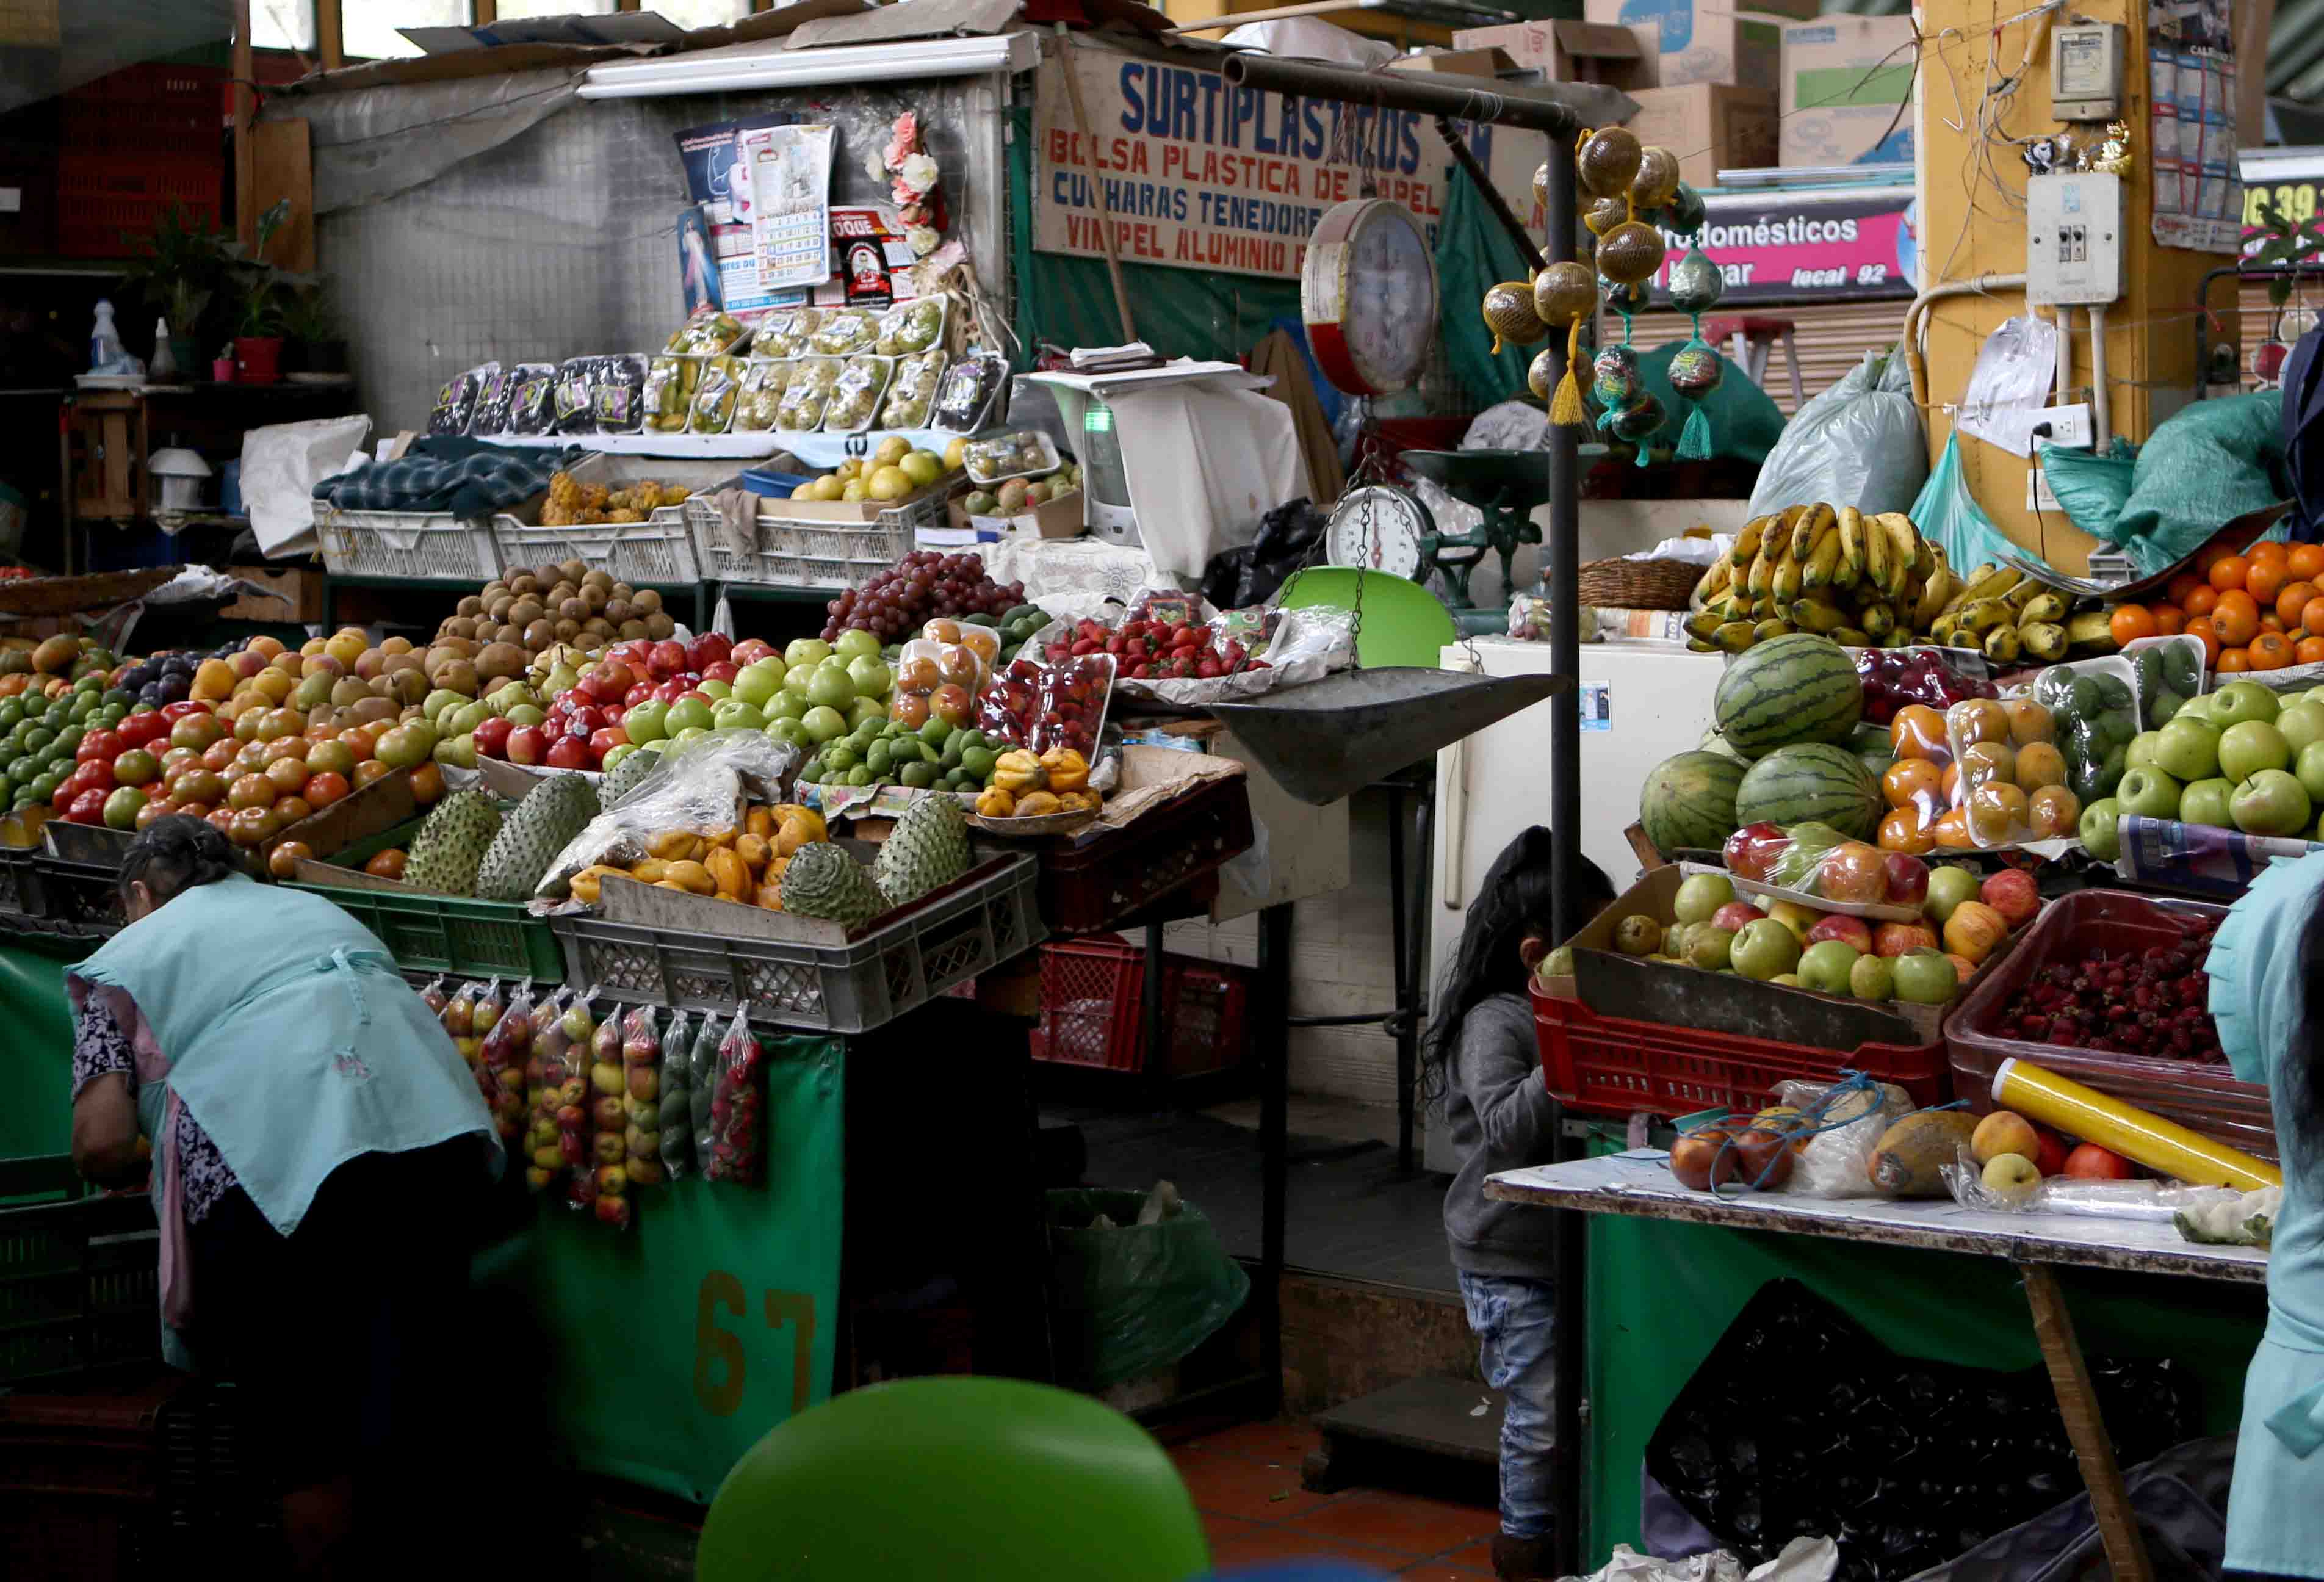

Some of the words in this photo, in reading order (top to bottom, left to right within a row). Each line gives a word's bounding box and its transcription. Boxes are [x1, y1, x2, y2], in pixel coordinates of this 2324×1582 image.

[1162, 144, 1300, 197] PLASTICA
[1314, 166, 1349, 203] DE
[1373, 177, 1441, 215] APEL
[831, 220, 873, 237] OQUE
[1175, 228, 1286, 273] ALUMINIO
[1791, 265, 1847, 288] local
[1857, 262, 1888, 286] 92
[694, 1269, 815, 1417] 67
